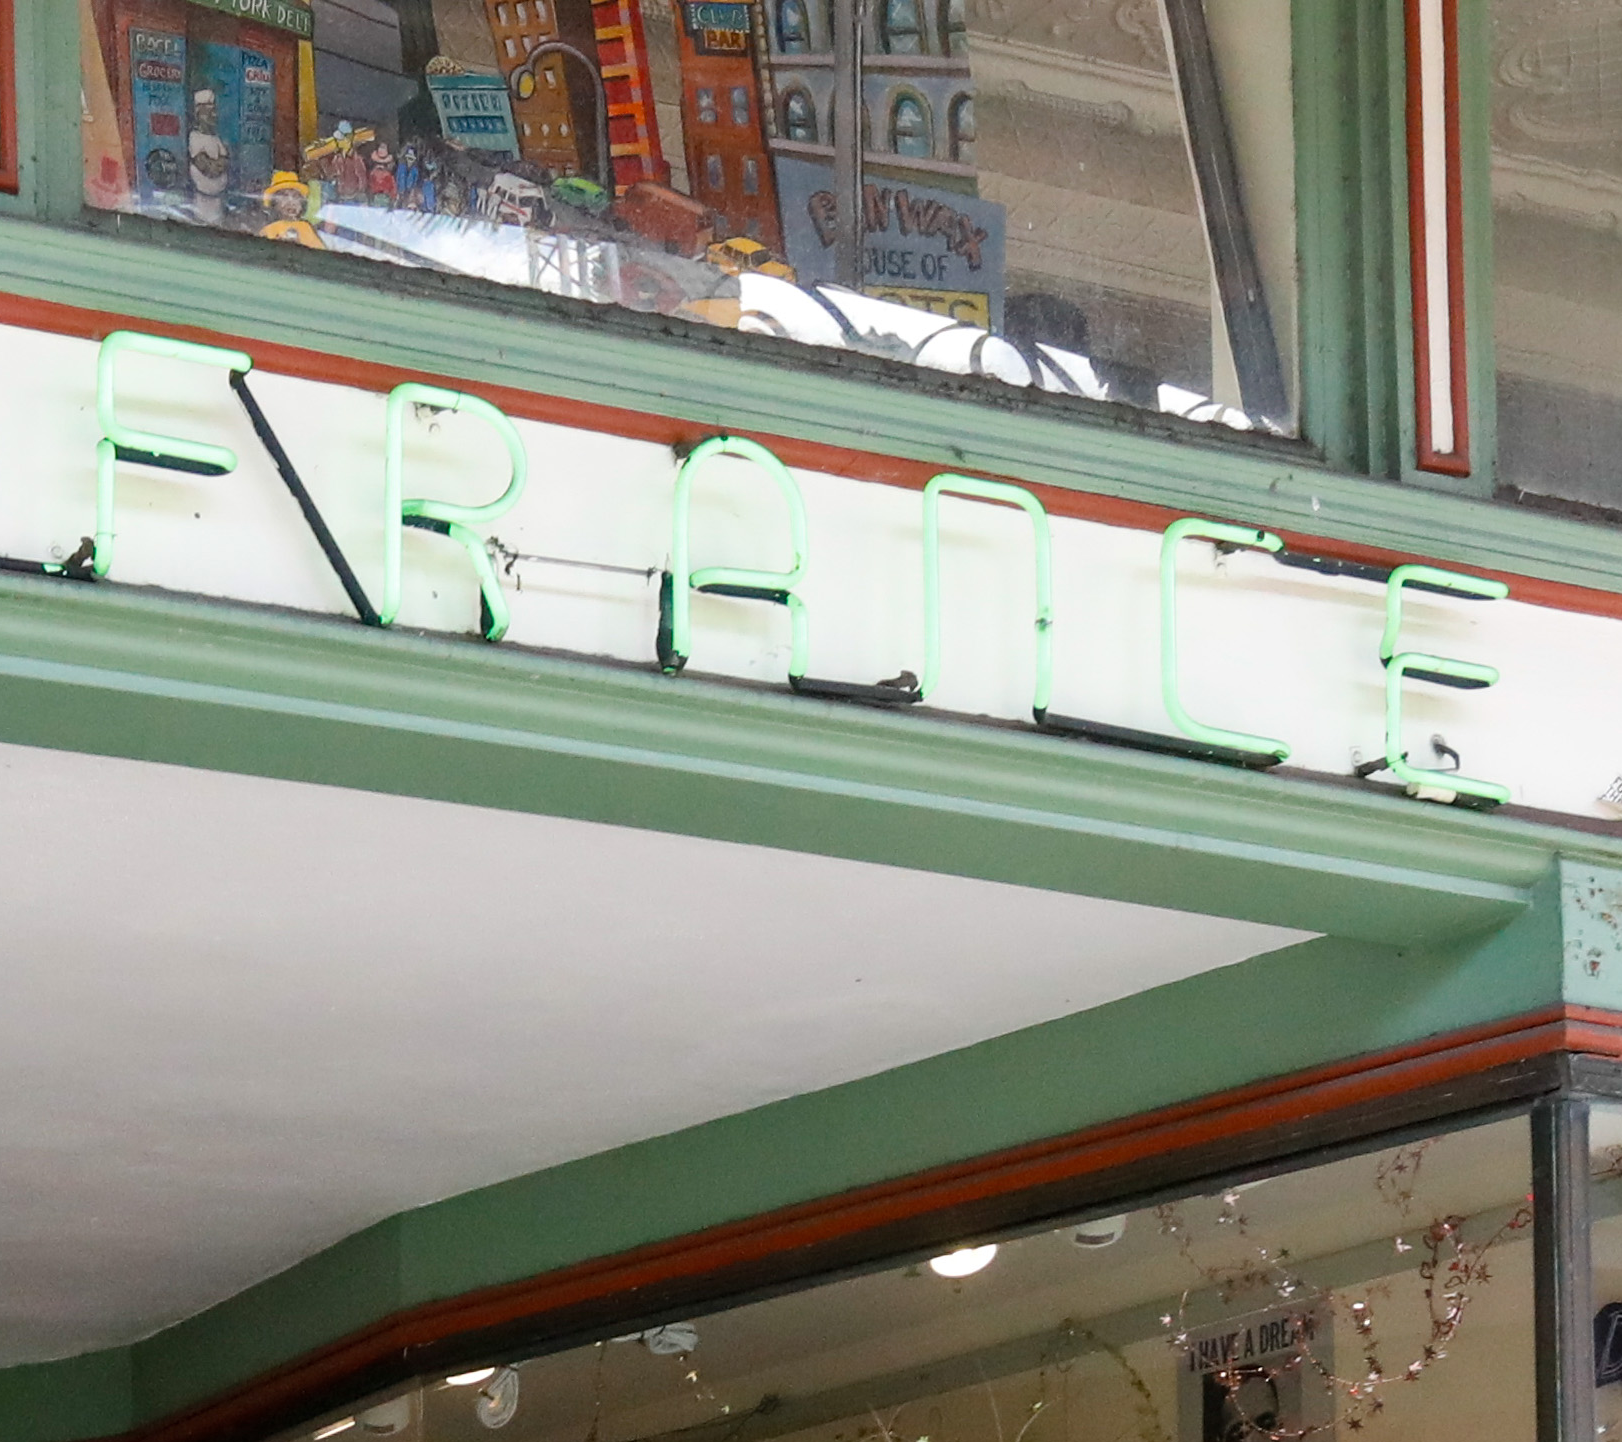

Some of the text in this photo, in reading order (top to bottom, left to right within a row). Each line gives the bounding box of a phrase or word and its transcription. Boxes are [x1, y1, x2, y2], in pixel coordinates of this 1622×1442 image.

[277, 8, 310, 32] DELI
[706, 30, 744, 49] BAR
[921, 253, 949, 282] OF
[1198, 1331, 1241, 1370] HAVE
[1244, 1328, 1254, 1359] A
